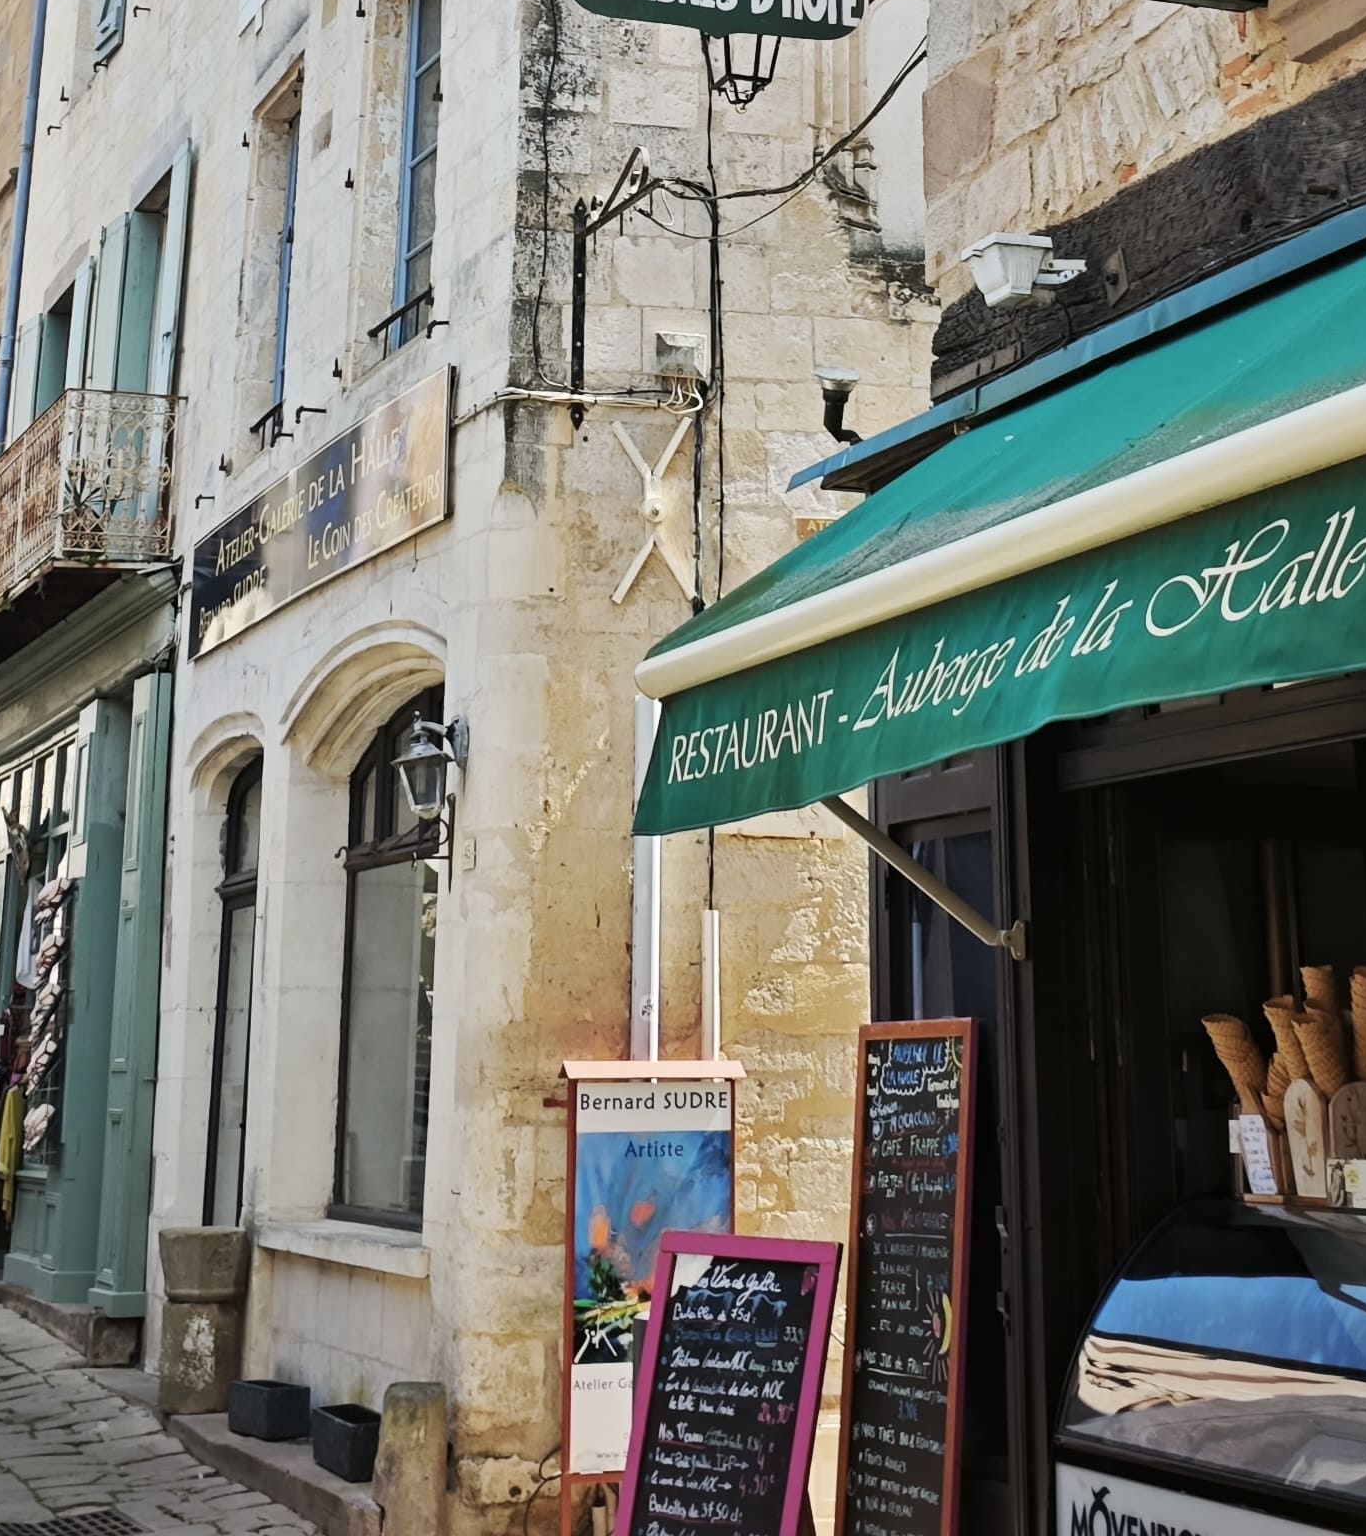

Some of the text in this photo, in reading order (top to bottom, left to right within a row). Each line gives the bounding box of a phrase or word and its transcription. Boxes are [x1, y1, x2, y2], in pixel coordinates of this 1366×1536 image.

[308, 475, 325, 513] DE
[328, 463, 345, 498] LA
[667, 688, 834, 784] RESTAURANT
[852, 645, 1015, 733] Auberge
[1014, 594, 1066, 677] de
[1070, 578, 1134, 658] la
[580, 1091, 728, 1111] Bernard SUDRE
[624, 1140, 684, 1158] Artiste
[573, 1379, 613, 1391] Atelier
